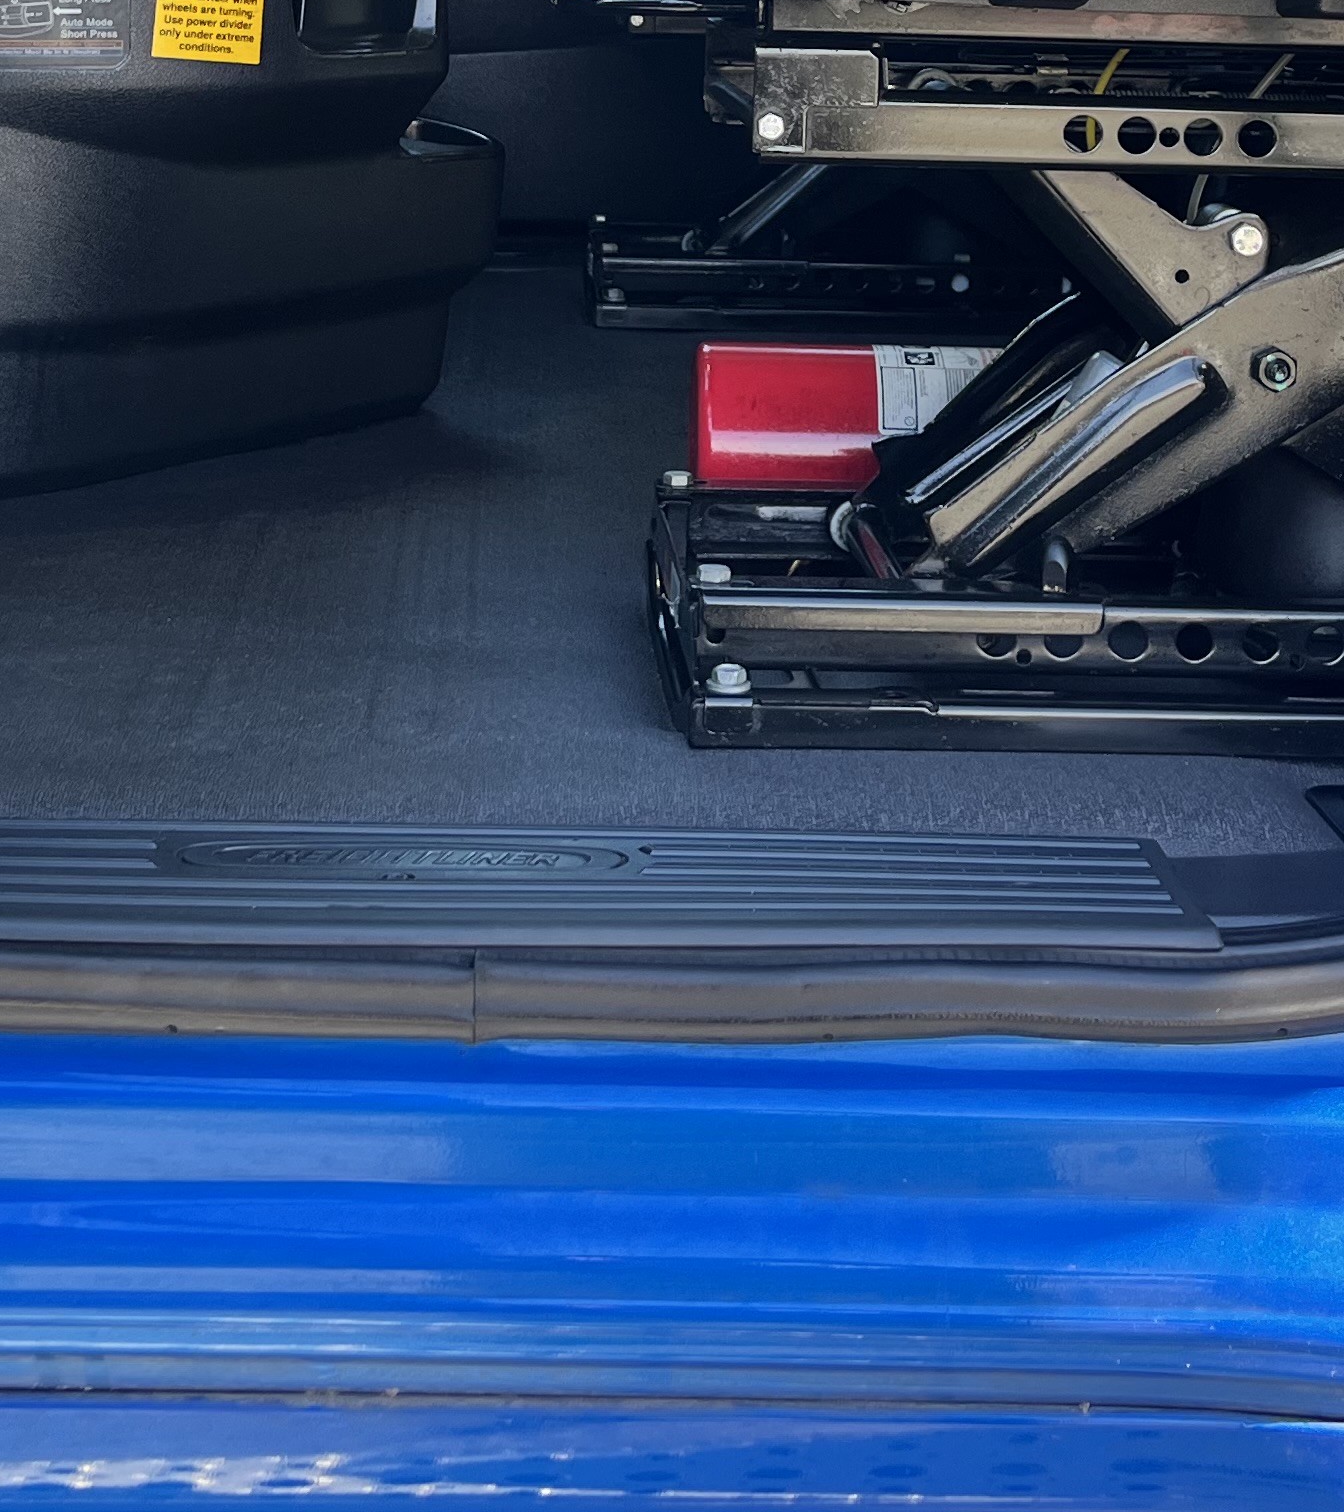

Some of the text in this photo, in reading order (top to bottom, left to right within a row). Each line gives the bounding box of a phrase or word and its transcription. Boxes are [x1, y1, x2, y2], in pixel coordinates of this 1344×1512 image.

[162, 3, 255, 20] wheels are turning.
[60, 17, 114, 27] Auto Mode
[164, 15, 252, 29] Use power divider
[60, 29, 118, 39] Short Press
[159, 28, 254, 43] only under extreme
[179, 43, 234, 54] conditions.
